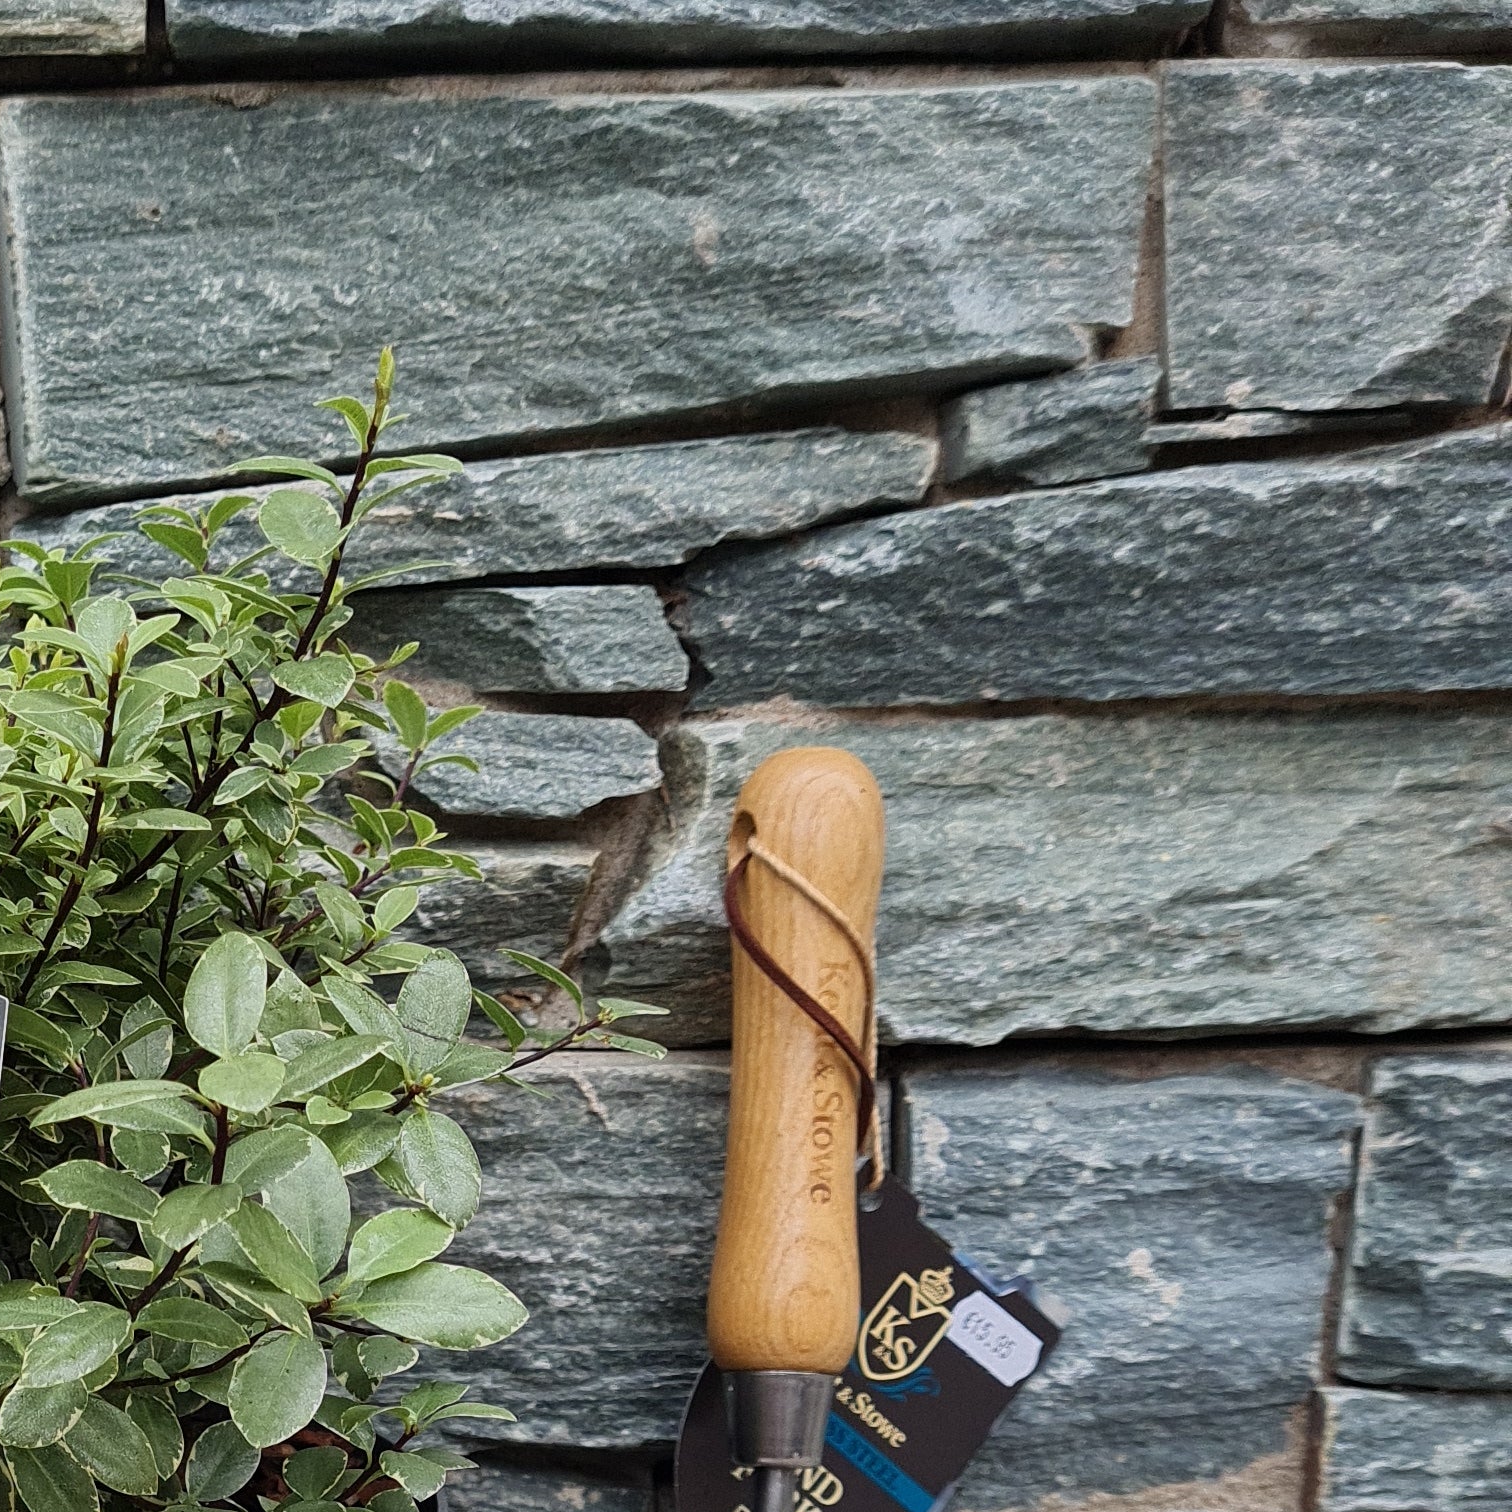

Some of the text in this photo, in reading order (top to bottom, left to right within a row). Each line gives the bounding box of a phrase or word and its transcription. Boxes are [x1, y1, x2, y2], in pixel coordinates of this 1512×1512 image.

[816, 960, 851, 1052] Ket
[809, 1088, 844, 1205] Stowe
[848, 1391, 908, 1448] Stowe
